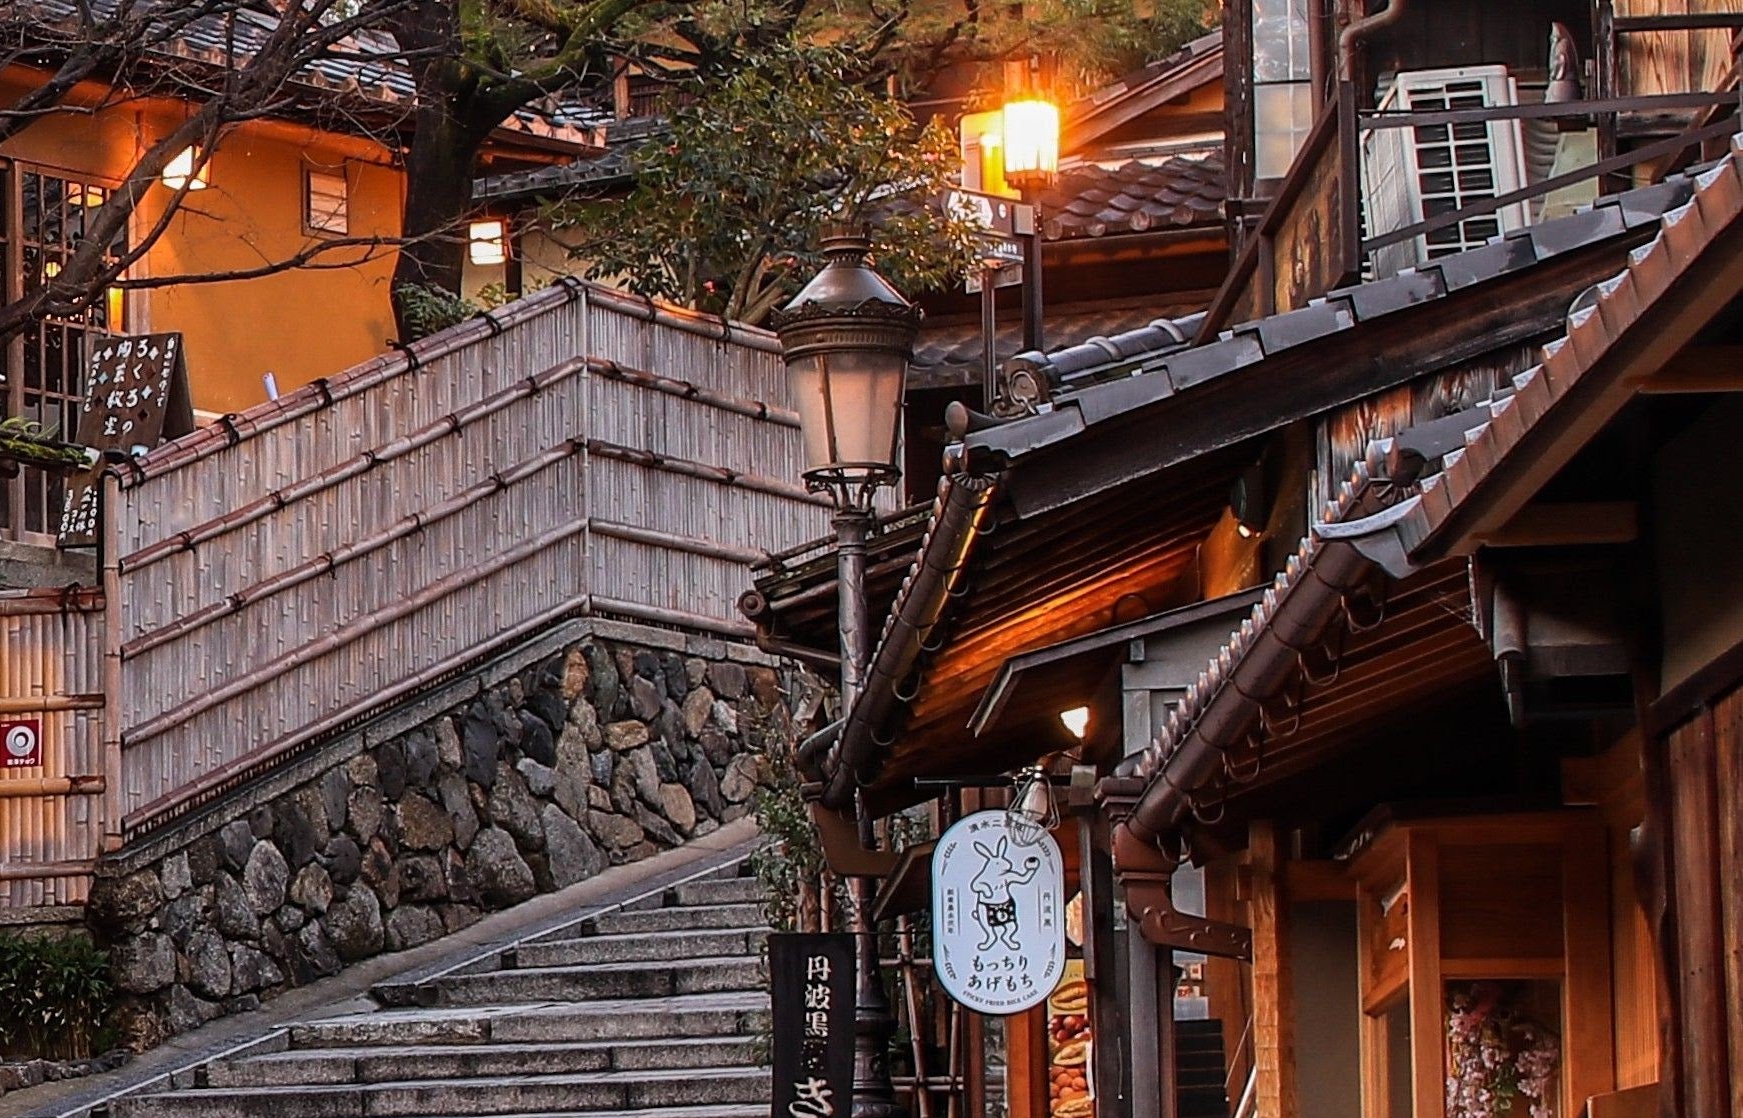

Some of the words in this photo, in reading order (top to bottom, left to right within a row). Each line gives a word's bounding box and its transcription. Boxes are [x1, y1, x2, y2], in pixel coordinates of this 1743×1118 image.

[972, 955, 1028, 973] もっちり
[967, 974, 1034, 993] あげもち
[805, 955, 832, 1038] 丹波黒
